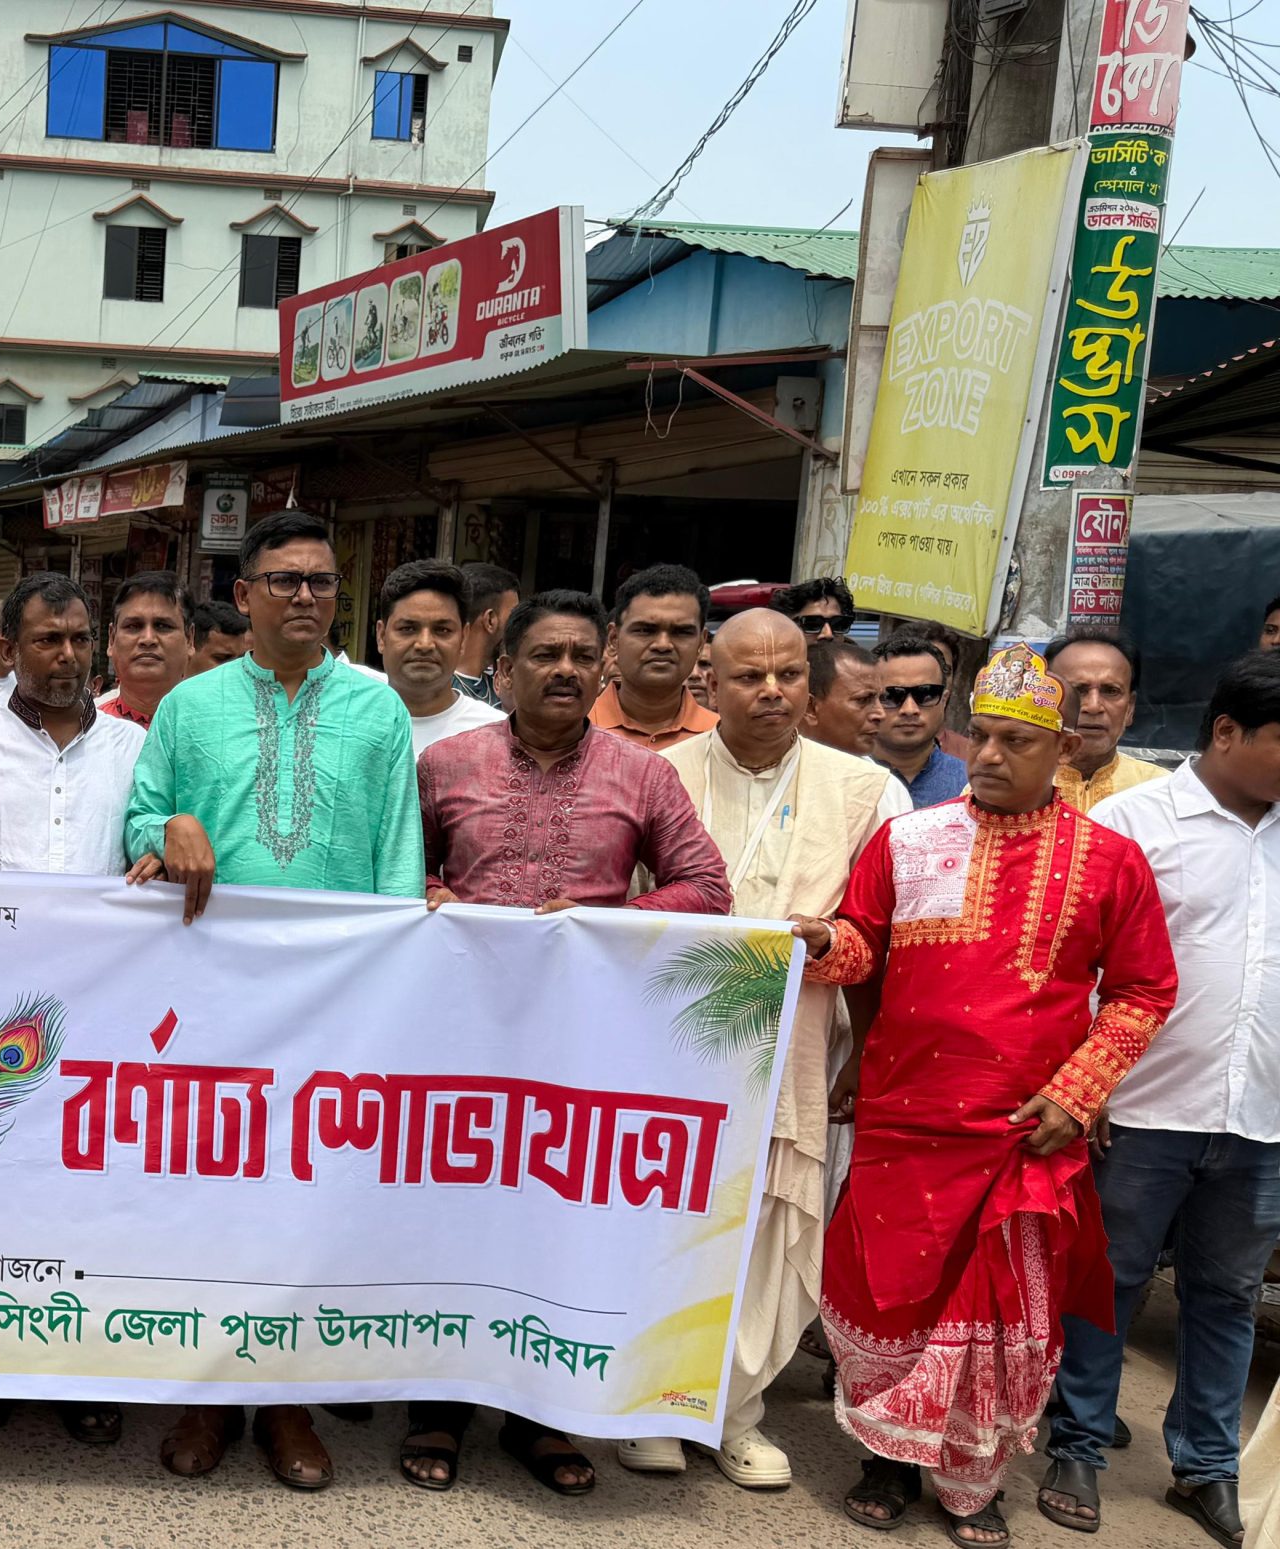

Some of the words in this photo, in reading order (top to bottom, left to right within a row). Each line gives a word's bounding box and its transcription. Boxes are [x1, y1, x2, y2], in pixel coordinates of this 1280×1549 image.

[1091, 140, 1148, 164] ভার্সিটি
[1129, 167, 1138, 176] &
[1094, 180, 1144, 194] স্পেশাল
[1087, 202, 1118, 213] এডমিশন
[1087, 213, 1124, 228] ডাবল
[476, 286, 540, 321] DURANTA
[497, 312, 526, 326] BICYCLE
[499, 333, 526, 349] জীবনের
[529, 326, 545, 341] গতি
[889, 297, 1033, 381] EXPORT
[900, 366, 991, 436] ZONE
[891, 469, 918, 486] এখানে
[920, 470, 942, 488] সকল
[944, 472, 969, 491] প্রকার
[1081, 499, 1125, 540] যৌন
[878, 530, 907, 549] পোষাক
[909, 533, 934, 554] পাওয়া
[1074, 577, 1090, 587] মাত্র
[1073, 590, 1096, 610] নিউ
[59, 1005, 274, 1182] বর্ণাঢ্য
[290, 1069, 728, 1214] শোভাযাত্রা
[105, 1308, 205, 1349] জেলা
[219, 1312, 304, 1363] পূজা
[314, 1304, 474, 1353] উদযাপন
[488, 1315, 616, 1382] পরিষদ
